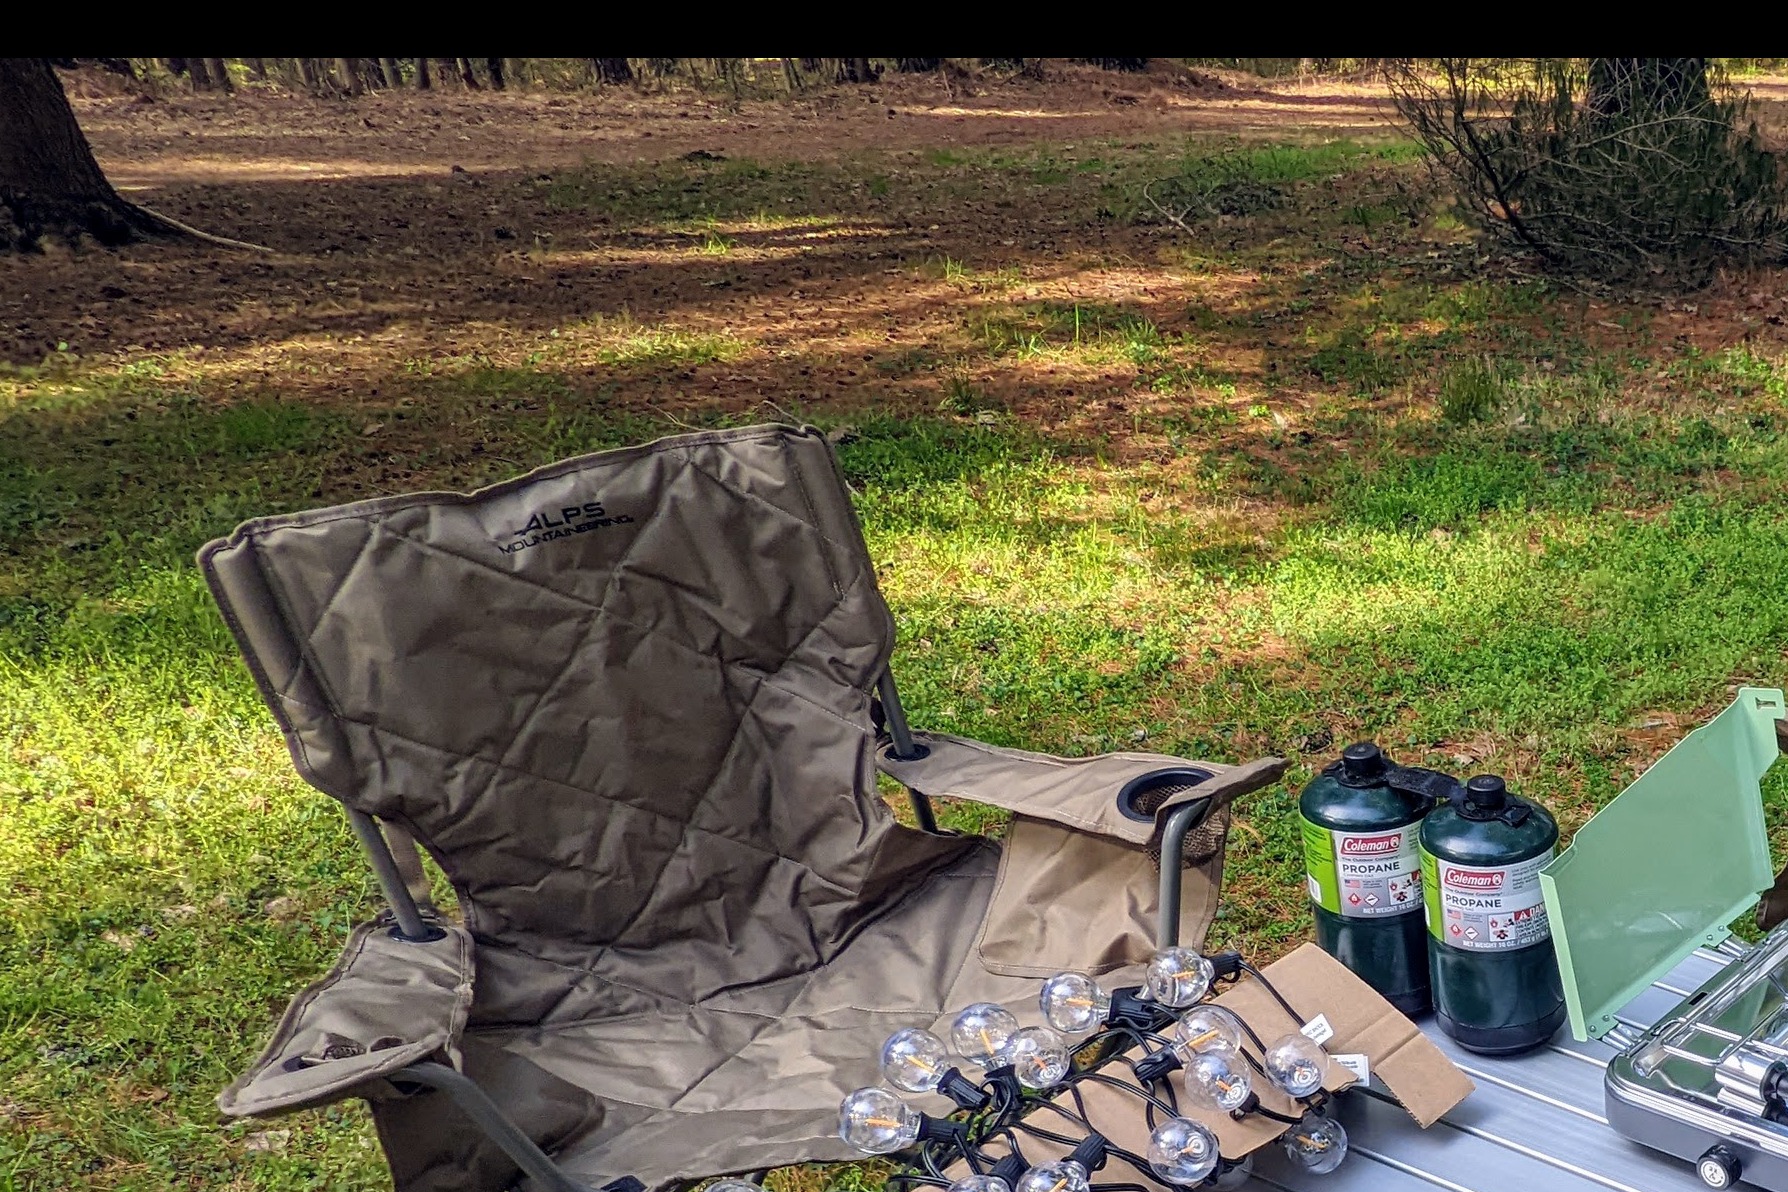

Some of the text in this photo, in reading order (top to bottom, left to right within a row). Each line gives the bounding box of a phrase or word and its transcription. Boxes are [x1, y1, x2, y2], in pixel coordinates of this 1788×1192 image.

[514, 501, 606, 536] ALPS
[498, 514, 634, 555] MOUNTAINEERING
[1344, 838, 1389, 851] Coleman
[1343, 861, 1400, 874] PROPANE
[1447, 870, 1491, 886] Coleman
[1446, 894, 1502, 908] PROPANE
